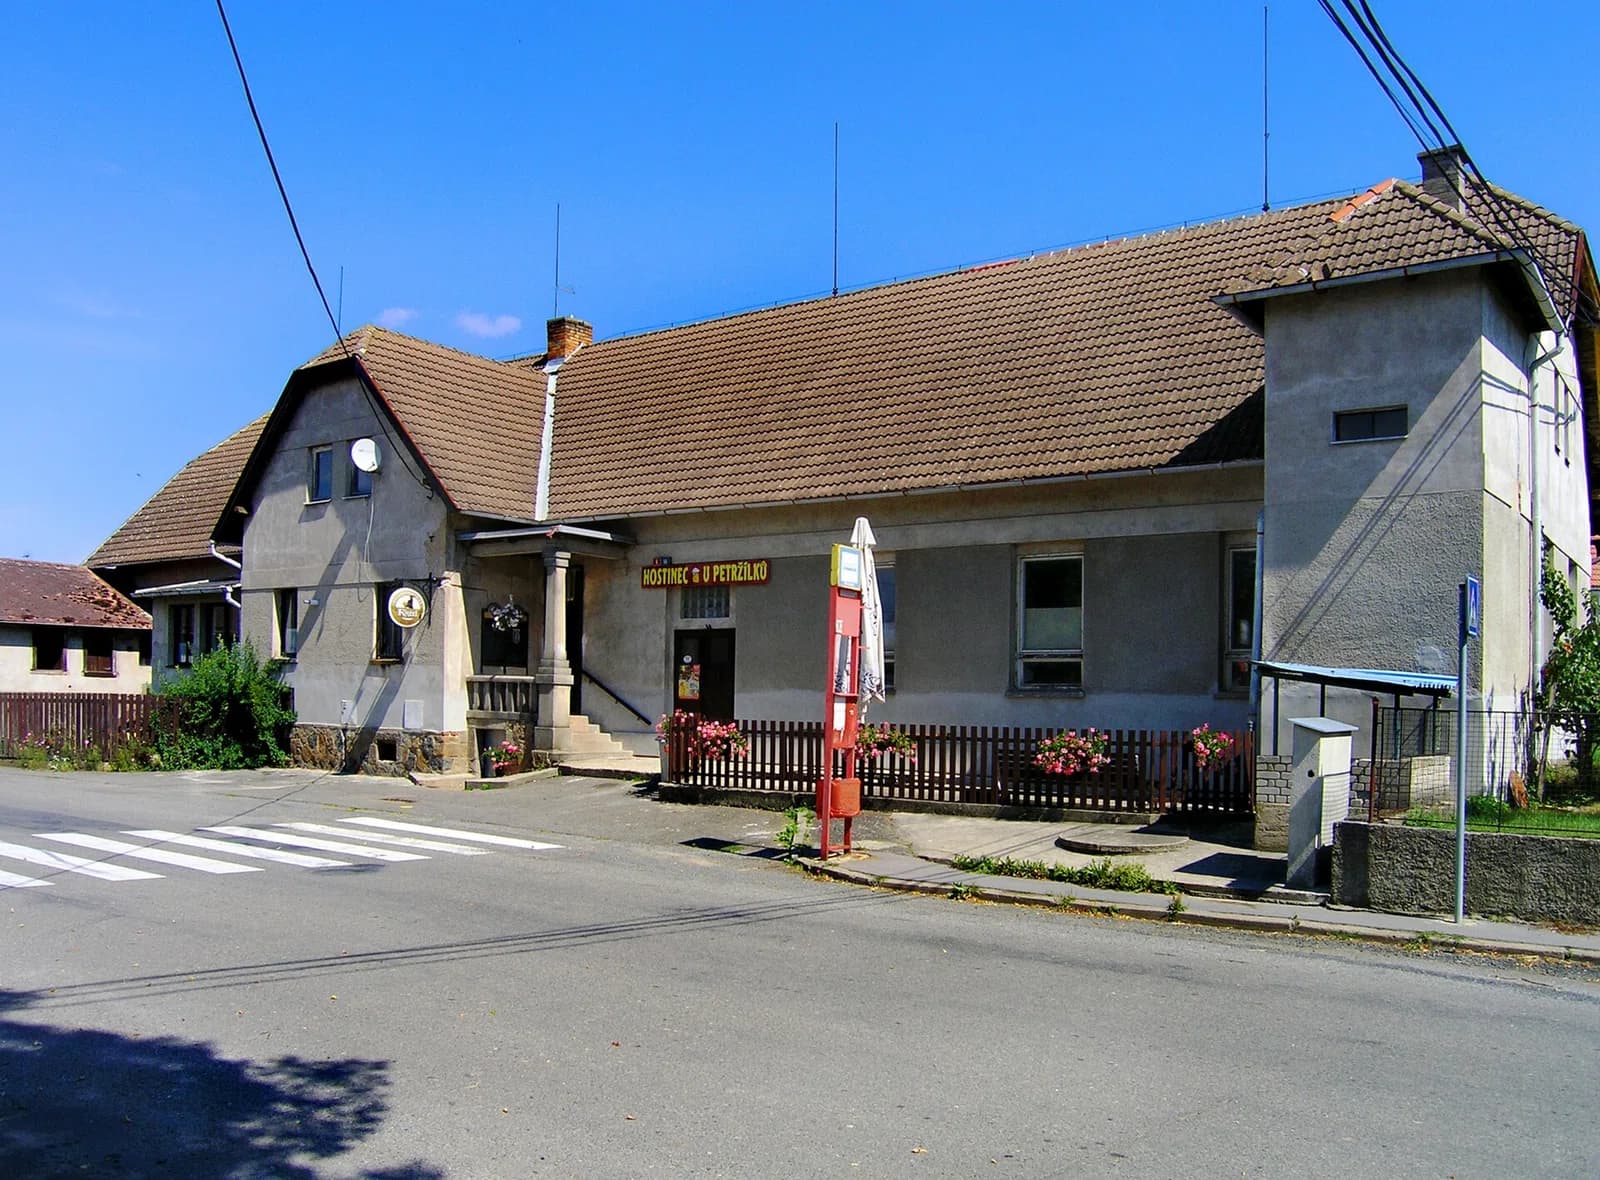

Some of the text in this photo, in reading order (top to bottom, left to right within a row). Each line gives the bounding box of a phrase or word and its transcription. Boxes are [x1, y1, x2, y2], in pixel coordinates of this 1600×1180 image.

[643, 561, 768, 585] HOSTINEC U PETRŽÍLKŮ
